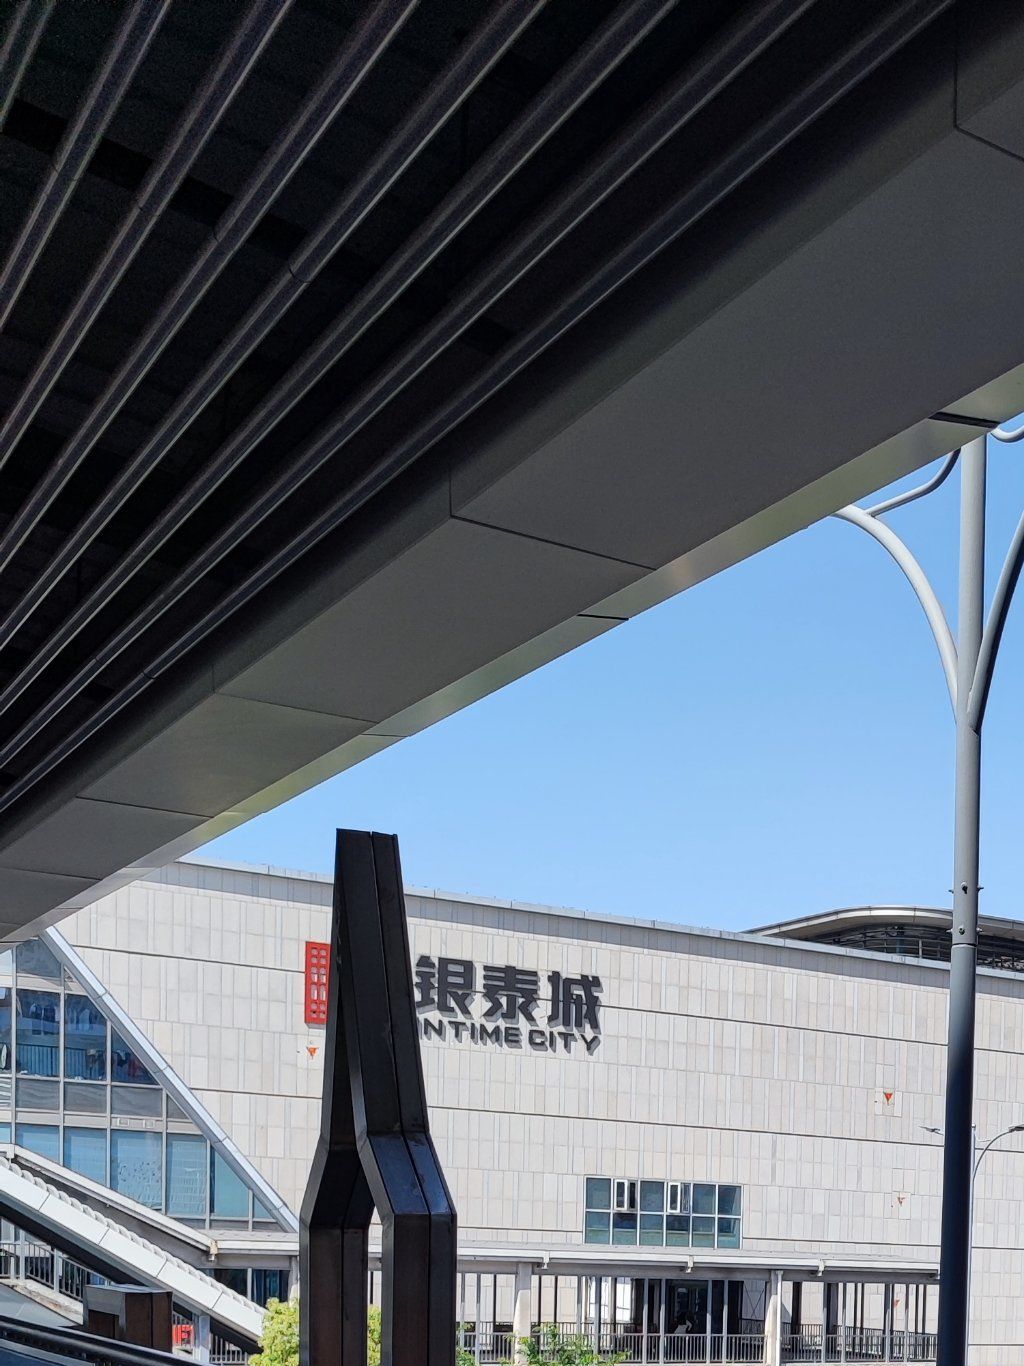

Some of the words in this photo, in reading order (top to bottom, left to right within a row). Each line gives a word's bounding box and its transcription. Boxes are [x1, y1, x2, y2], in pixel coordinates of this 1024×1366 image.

[415, 955, 602, 1033] 银泰城
[418, 1017, 521, 1048] NTIME
[528, 1029, 600, 1055] CITY
